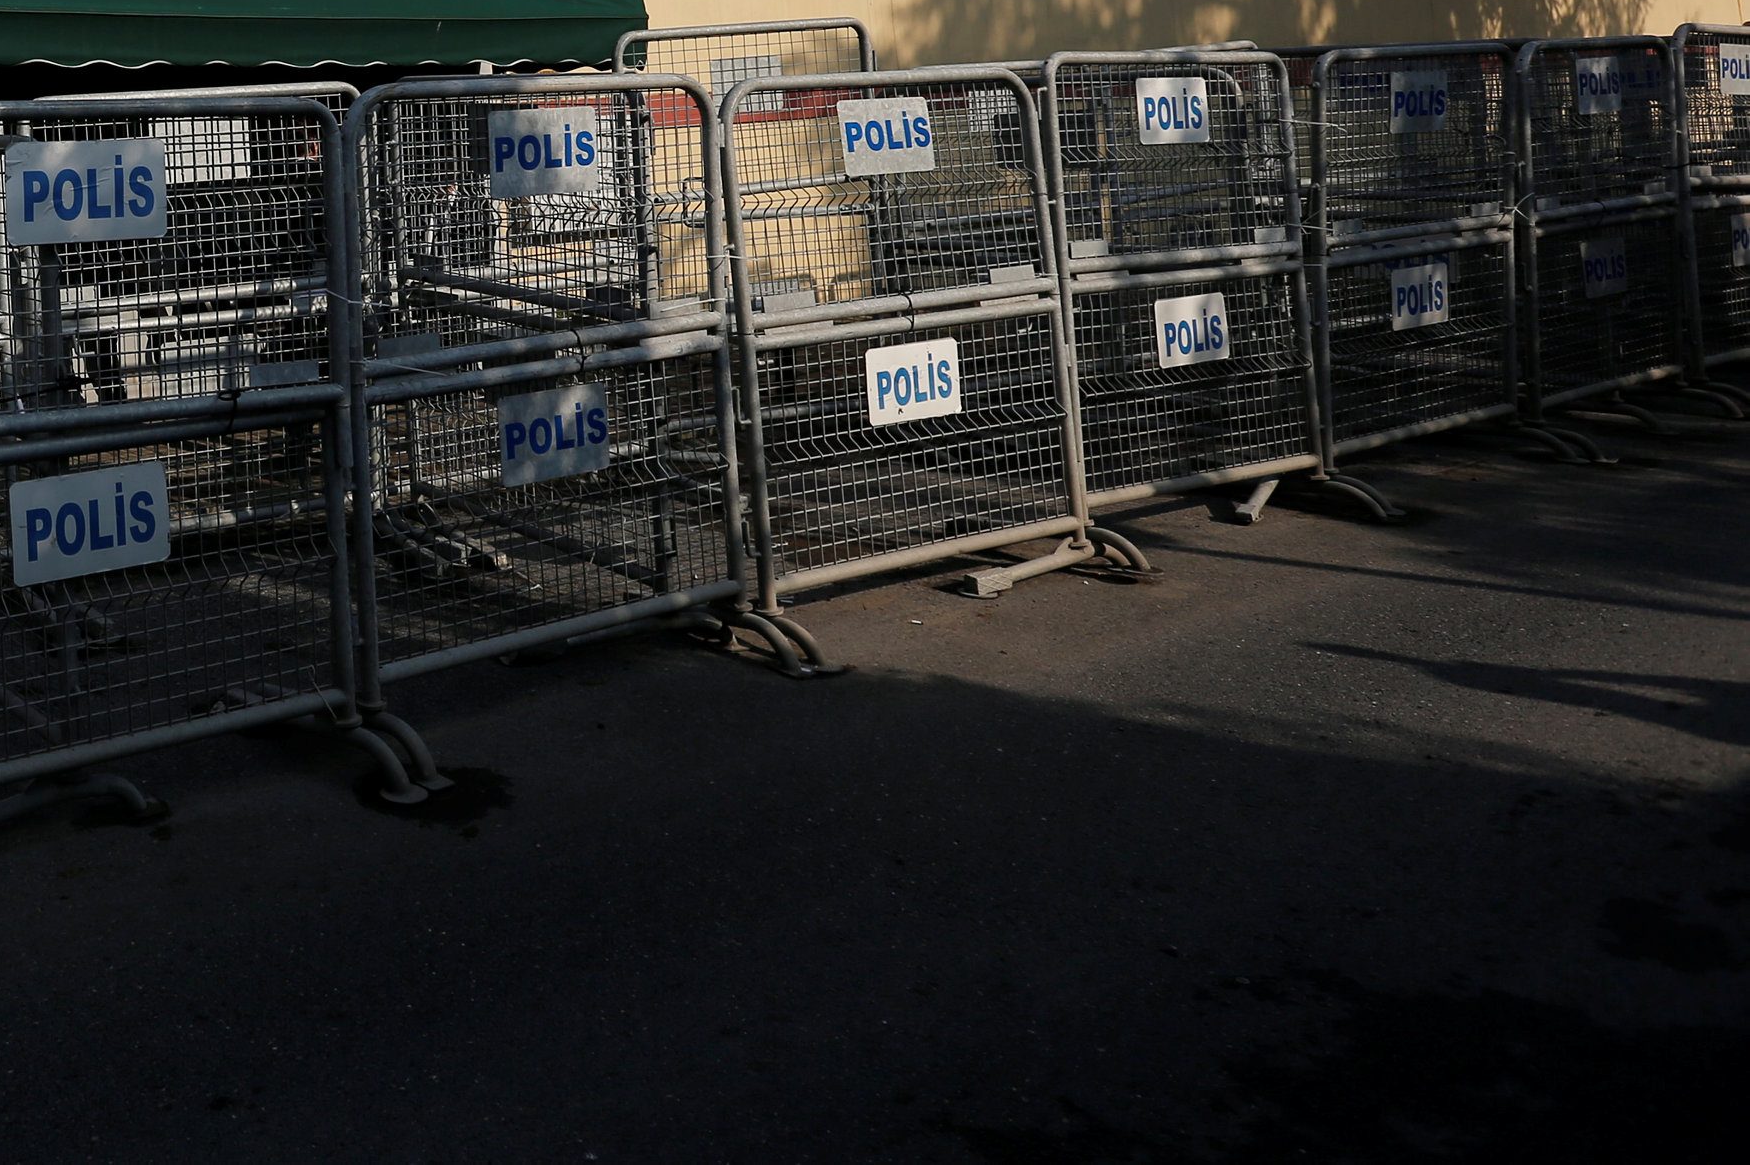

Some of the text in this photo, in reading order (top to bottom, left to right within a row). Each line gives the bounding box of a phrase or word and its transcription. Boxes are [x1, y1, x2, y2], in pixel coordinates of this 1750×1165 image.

[1579, 67, 1620, 96] POLİS
[1722, 54, 1750, 80] POLİ
[1144, 88, 1203, 131] POLİS
[1394, 85, 1446, 117] POLİS
[494, 124, 595, 172] POLİS
[845, 110, 931, 152] POLİS
[22, 155, 154, 222] POLİS
[1585, 249, 1625, 283] POLİS
[1396, 274, 1443, 317] POLİS
[1164, 309, 1223, 356] POLİS
[876, 353, 952, 409] POLİS
[505, 402, 607, 460] POLİS
[26, 482, 154, 561] POLİS
